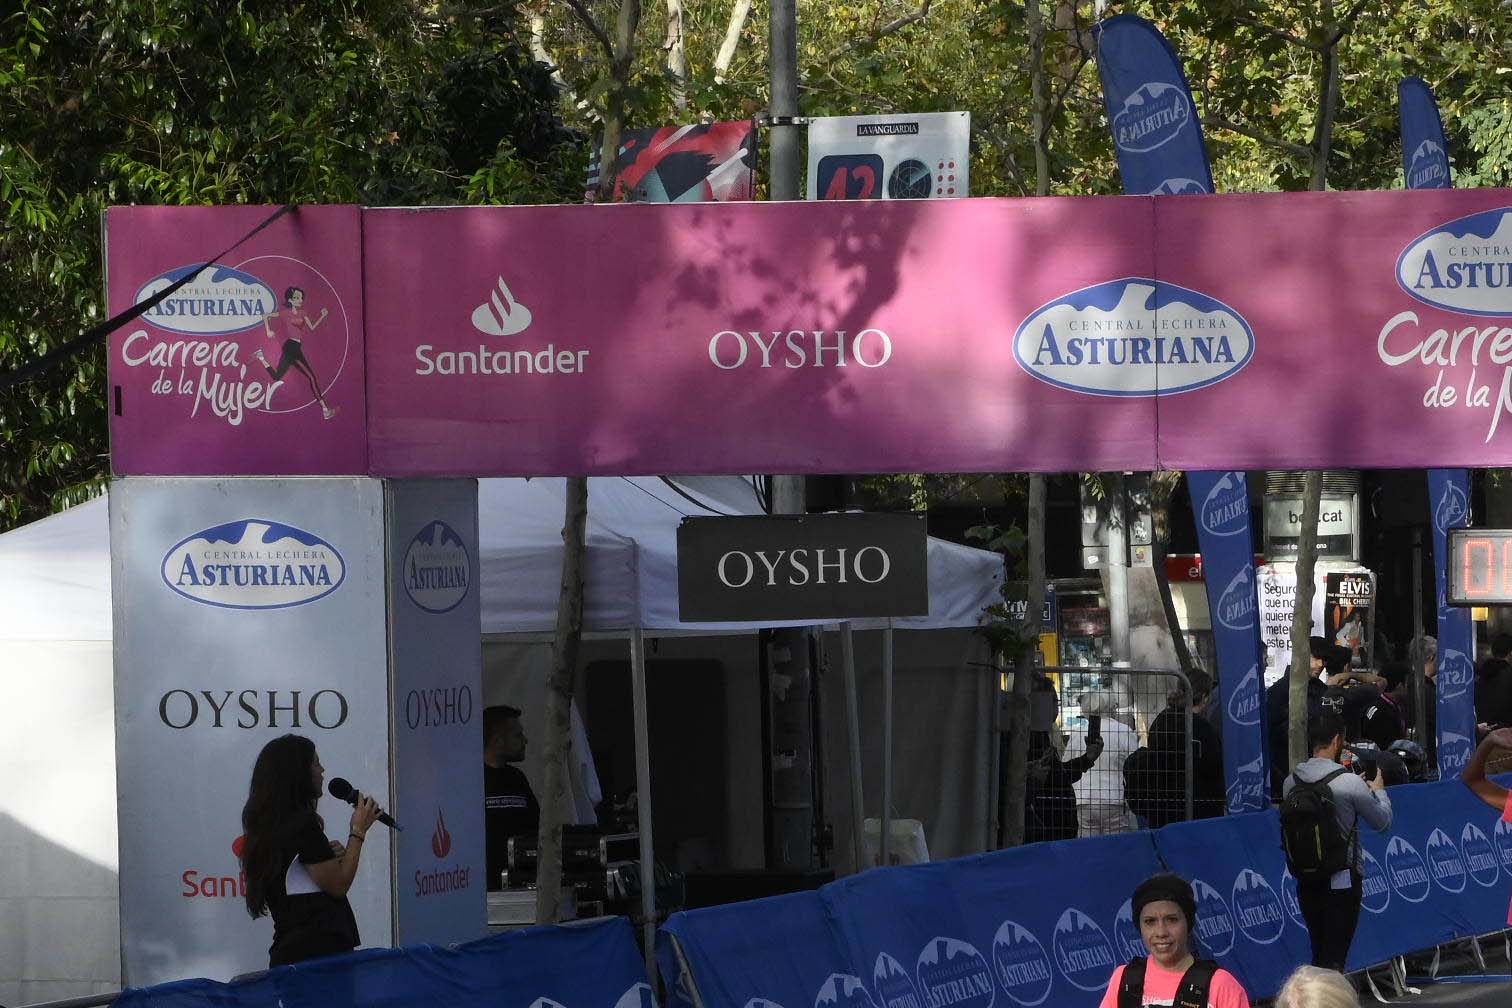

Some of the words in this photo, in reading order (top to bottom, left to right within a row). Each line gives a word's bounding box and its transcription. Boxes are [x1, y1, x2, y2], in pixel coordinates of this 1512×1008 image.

[173, 287, 211, 297] ENTRAL
[1069, 318, 1146, 332] CENTRAL
[1150, 317, 1229, 330] LECHERA
[122, 330, 240, 367] Carrera
[415, 344, 590, 377] Santander
[708, 329, 893, 371] OYSHO
[1032, 322, 1235, 365] ASTURIANA
[151, 371, 173, 395] de
[178, 370, 194, 395] la
[190, 363, 284, 426] Mujer
[1422, 371, 1457, 408] de
[1466, 370, 1490, 408] la
[1289, 509, 1343, 524] b.cat
[176, 553, 333, 588] ASTURIANA
[203, 551, 261, 561] CENTRAL
[267, 550, 327, 560] LECHERA
[408, 553, 467, 592] ASTURIANA
[717, 546, 891, 588] OYSHO
[1265, 599, 1280, 610] que
[1340, 582, 1370, 595] ELVIS
[1266, 637, 1285, 649] este
[158, 689, 349, 730] OYSHO
[405, 684, 473, 731] OYSHO
[414, 864, 471, 897] Santander
